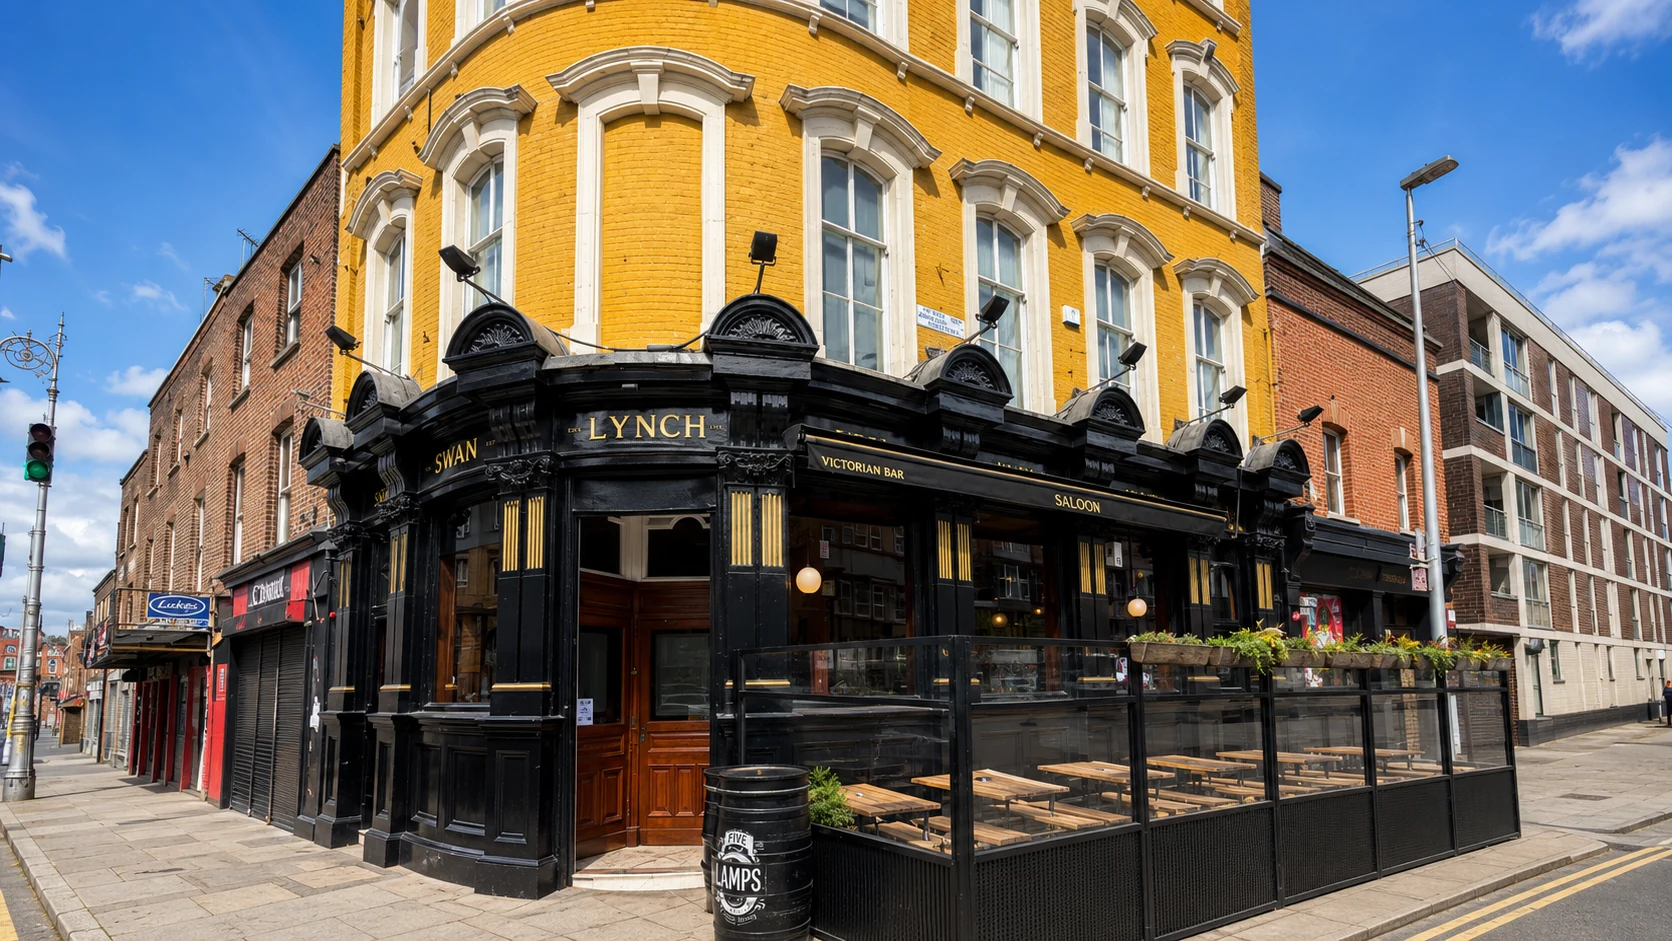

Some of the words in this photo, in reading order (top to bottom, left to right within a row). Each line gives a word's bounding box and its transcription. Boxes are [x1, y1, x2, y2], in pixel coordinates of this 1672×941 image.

[589, 414, 706, 440] LYNCH
[435, 438, 477, 474] SWAN
[821, 455, 881, 475] VICTORIAN
[884, 467, 905, 480] BAR
[1054, 493, 1101, 514] SALOON
[727, 832, 748, 846] FIVE
[715, 862, 762, 892] LAMPS
